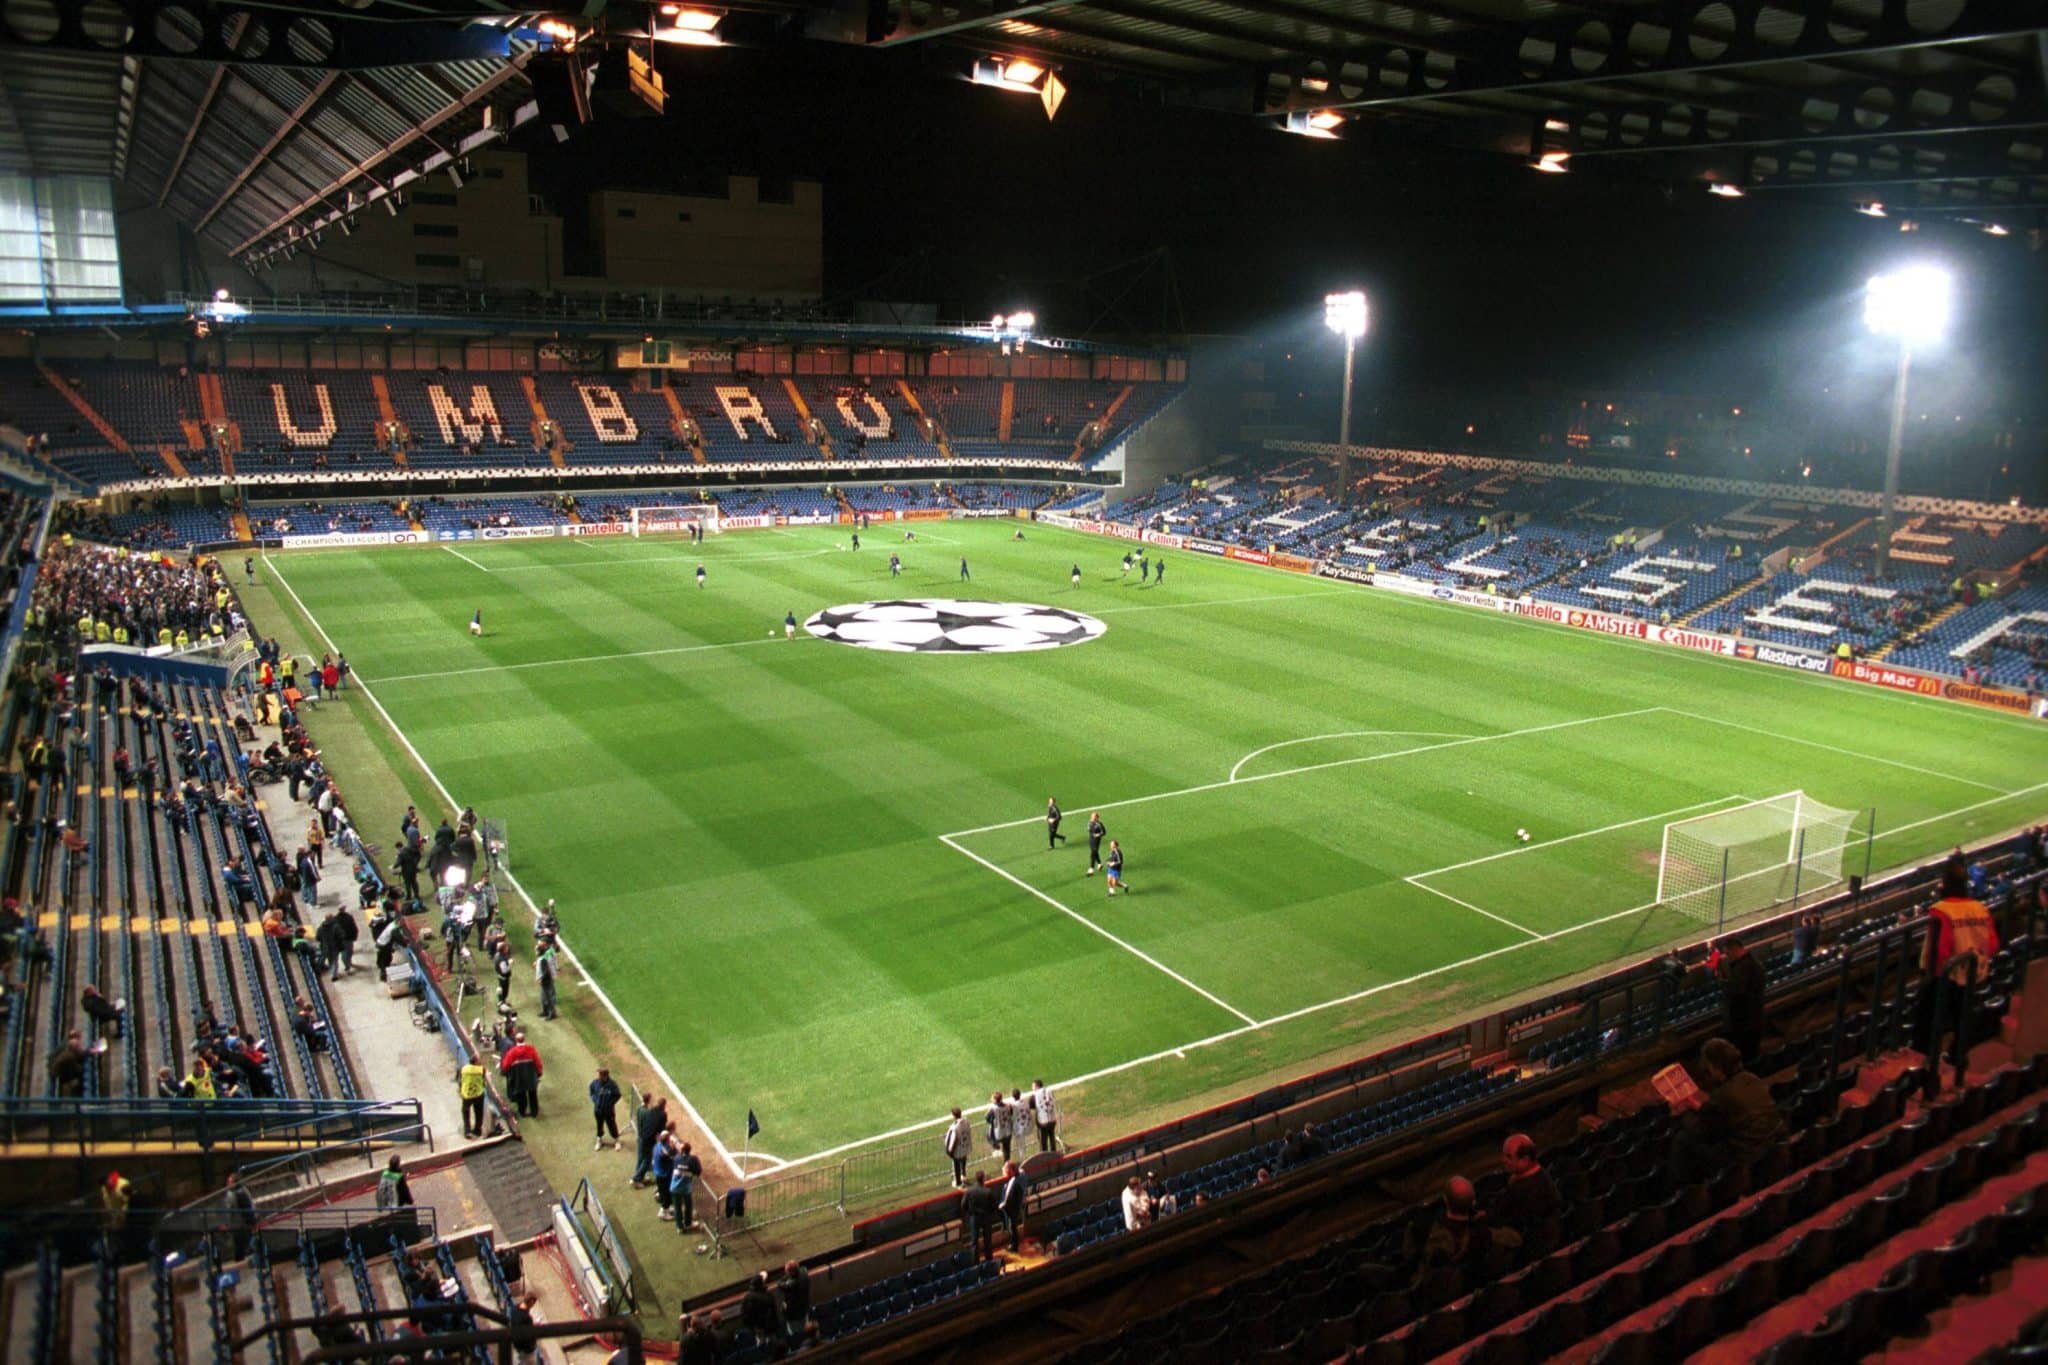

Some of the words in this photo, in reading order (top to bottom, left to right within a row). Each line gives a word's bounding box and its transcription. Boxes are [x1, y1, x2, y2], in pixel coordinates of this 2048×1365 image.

[963, 508, 1009, 518] PlayStation
[579, 520, 624, 535] nutella
[718, 516, 761, 528] Canon
[295, 535, 345, 546] CHAMPIONS
[348, 534, 377, 544] LEAGUE
[530, 528, 553, 536] fiesta
[1111, 523, 1140, 540] AMSTEL
[1147, 531, 1179, 547] Canon
[1319, 564, 1374, 583] PlayStation
[1454, 592, 1472, 603] new
[1473, 594, 1496, 608] fiesta
[1513, 600, 1562, 621] nutella
[1583, 616, 1643, 637] AMSTEL
[1658, 626, 1725, 652] Canon
[1756, 646, 1827, 672] MasterCard
[1854, 665, 1879, 683] Big
[1882, 671, 1916, 687] Mac
[1943, 682, 2032, 710] Continental
